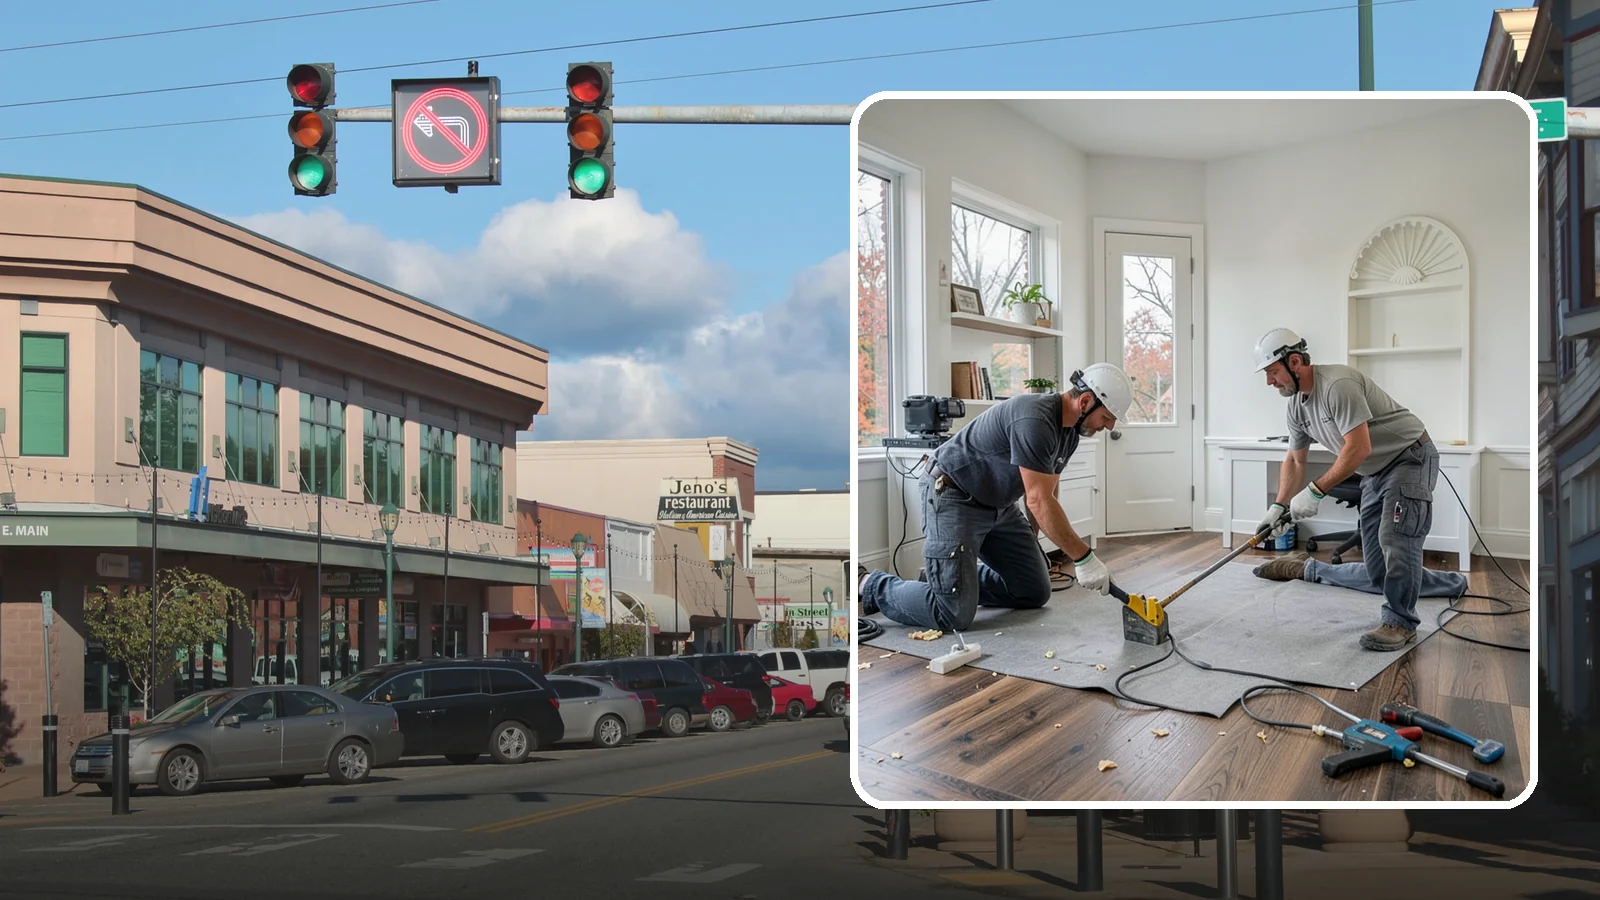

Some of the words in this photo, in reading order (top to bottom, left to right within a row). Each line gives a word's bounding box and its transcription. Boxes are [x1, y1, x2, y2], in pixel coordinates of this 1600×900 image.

[669, 480, 727, 495] Jeno's
[665, 496, 731, 509] restaurant
[686, 510, 715, 520] American
[715, 510, 738, 520] Cuisine
[2, 525, 13, 536] E.
[15, 525, 49, 536] MAIN
[797, 607, 828, 617] Street
[791, 619, 823, 627] lass
